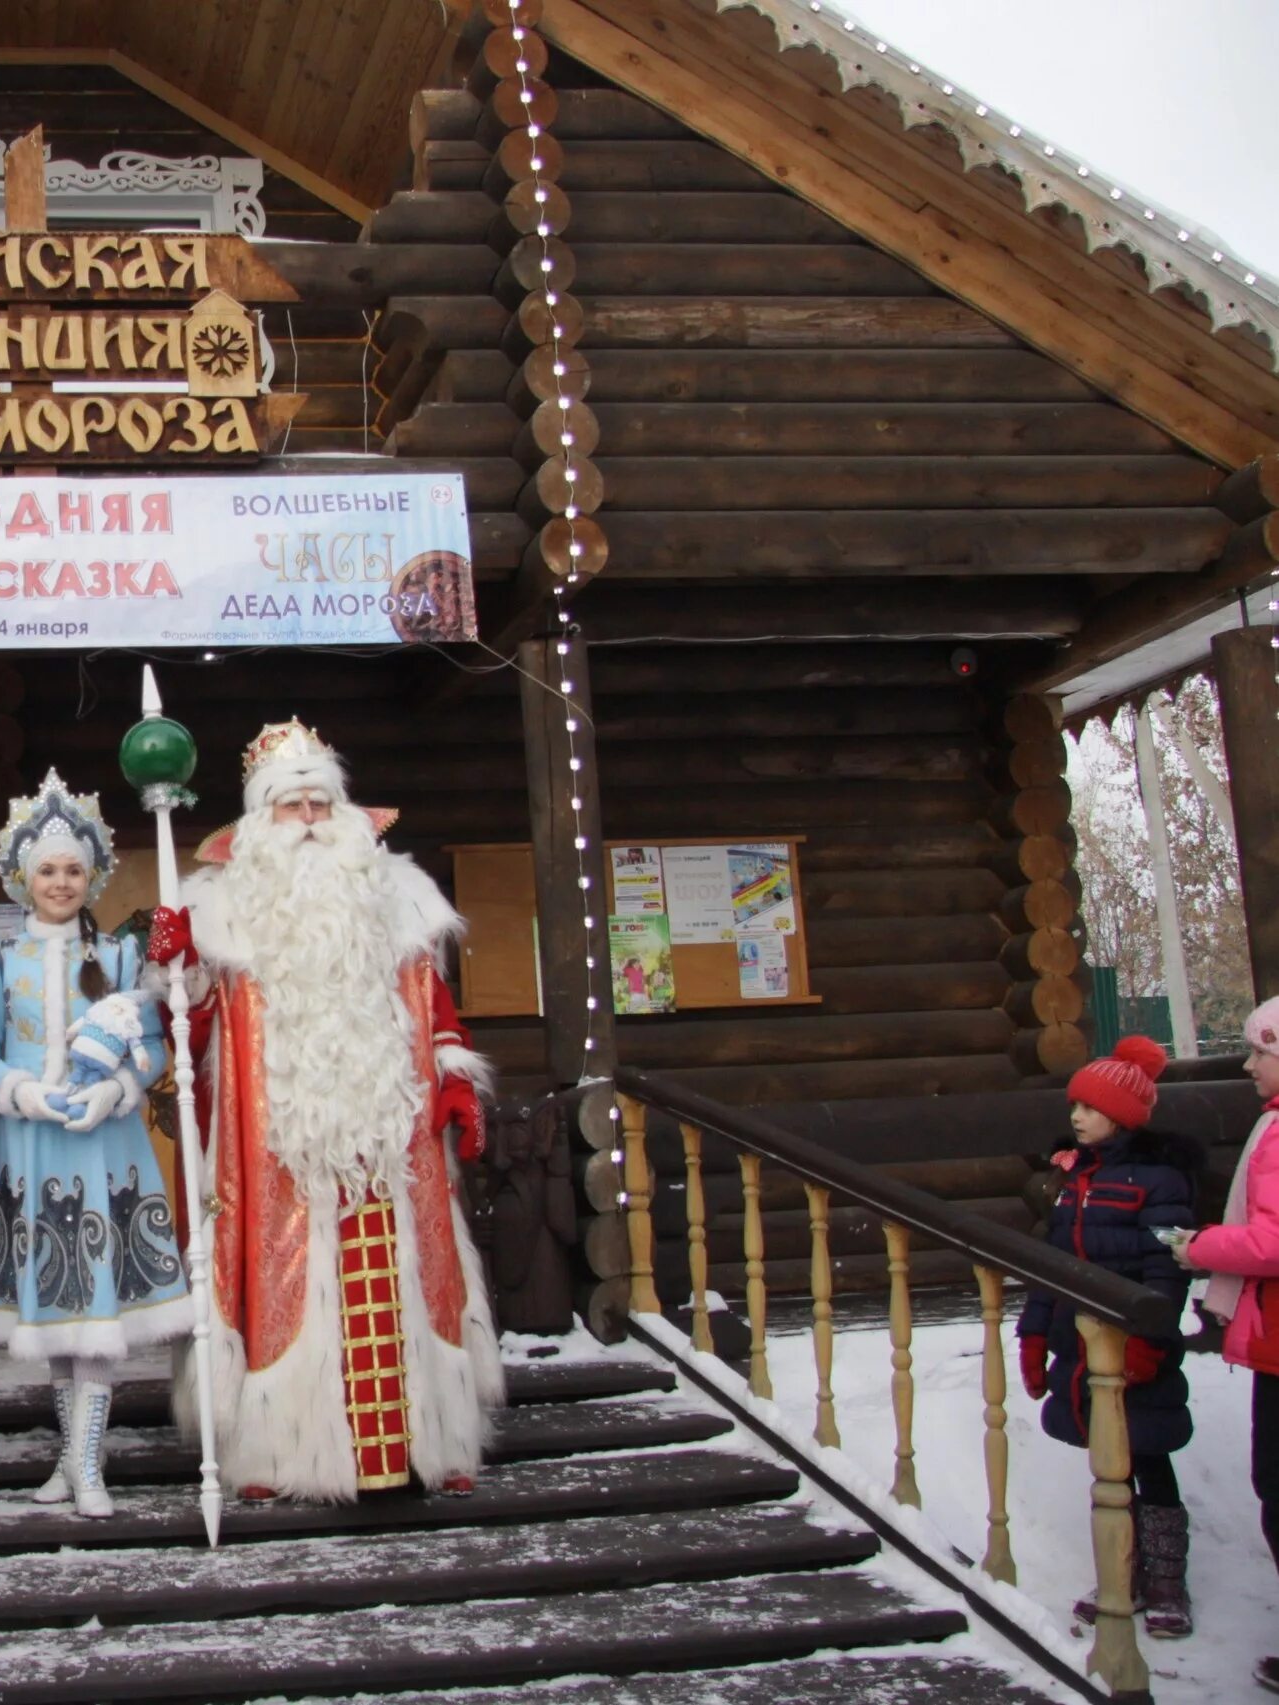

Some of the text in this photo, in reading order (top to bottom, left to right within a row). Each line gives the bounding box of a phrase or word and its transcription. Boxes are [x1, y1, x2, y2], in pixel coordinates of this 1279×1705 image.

[232, 491, 410, 516] ВОЛШЕБНЫЕ
[254, 533, 396, 583] ЧАСЫ
[221, 592, 438, 620] ДЕДА МОРОЗА
[15, 620, 89, 640] января
